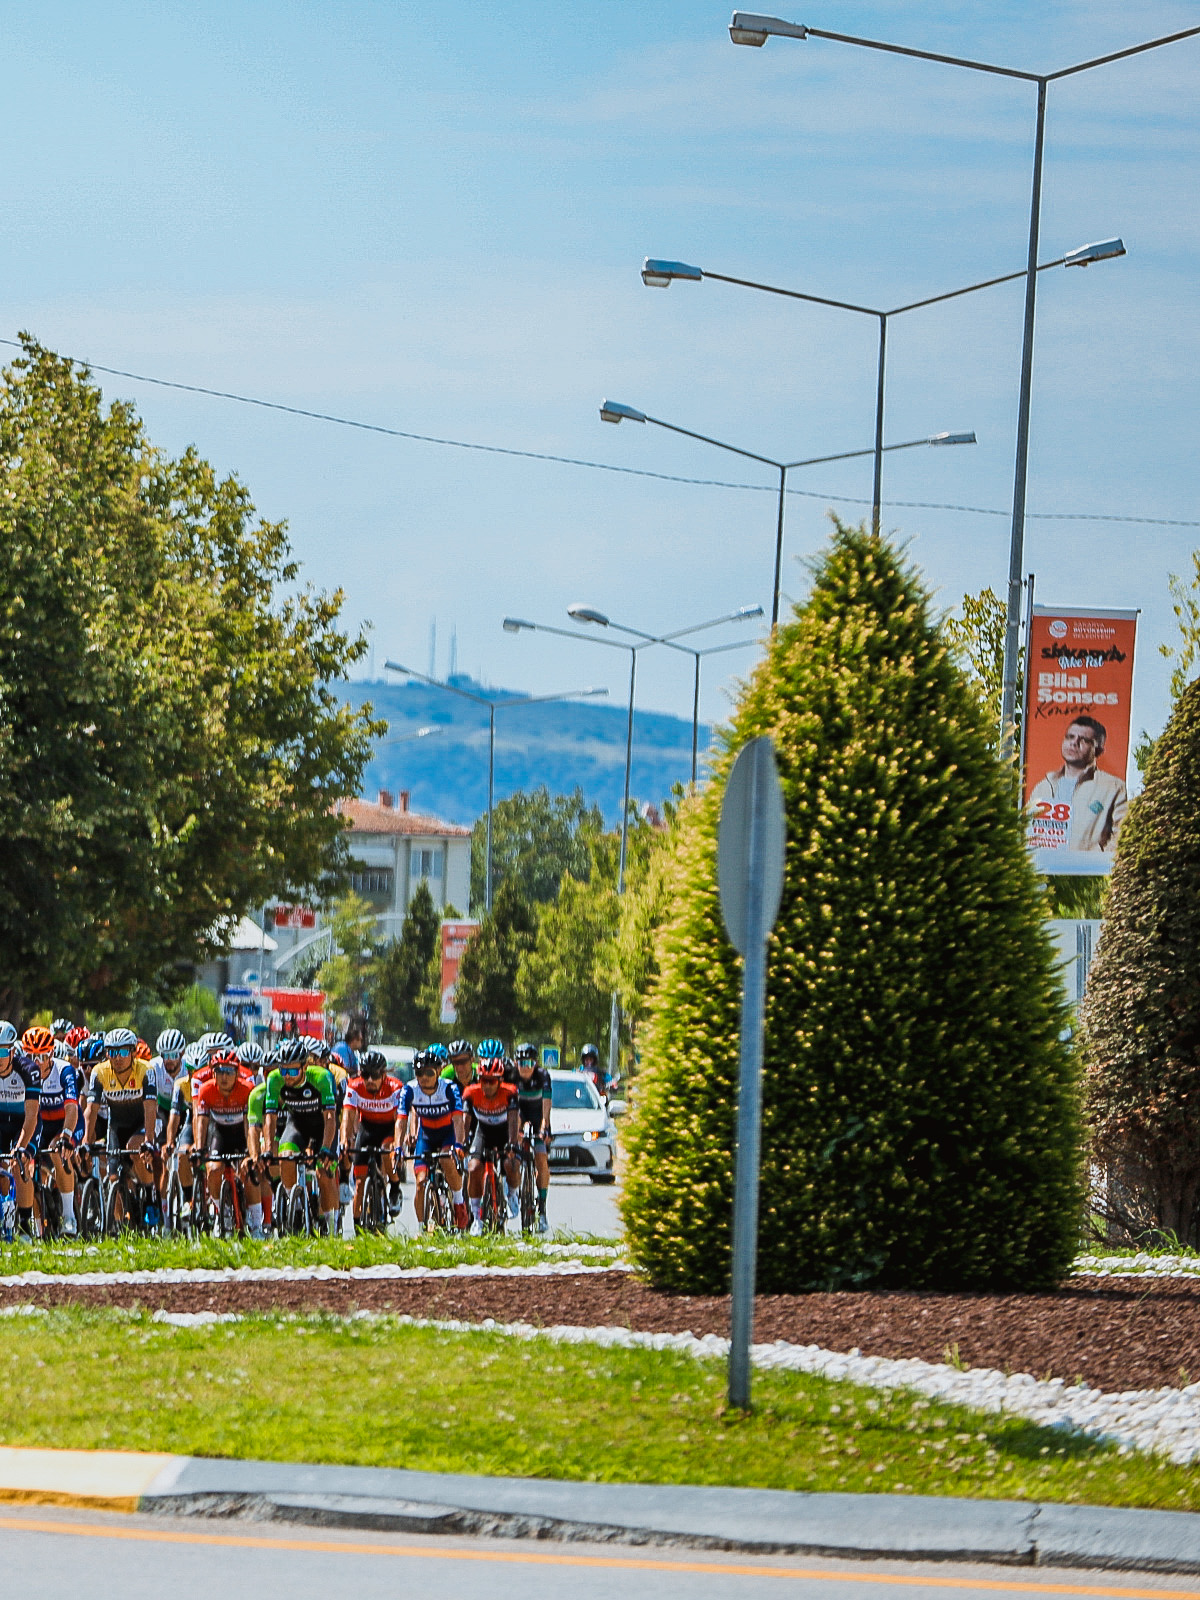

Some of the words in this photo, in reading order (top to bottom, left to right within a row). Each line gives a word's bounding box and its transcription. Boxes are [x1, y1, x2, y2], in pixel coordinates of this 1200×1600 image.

[1038, 671, 1088, 689] Bilal
[1037, 687, 1119, 705] Sonses
[1033, 801, 1071, 822] 28
